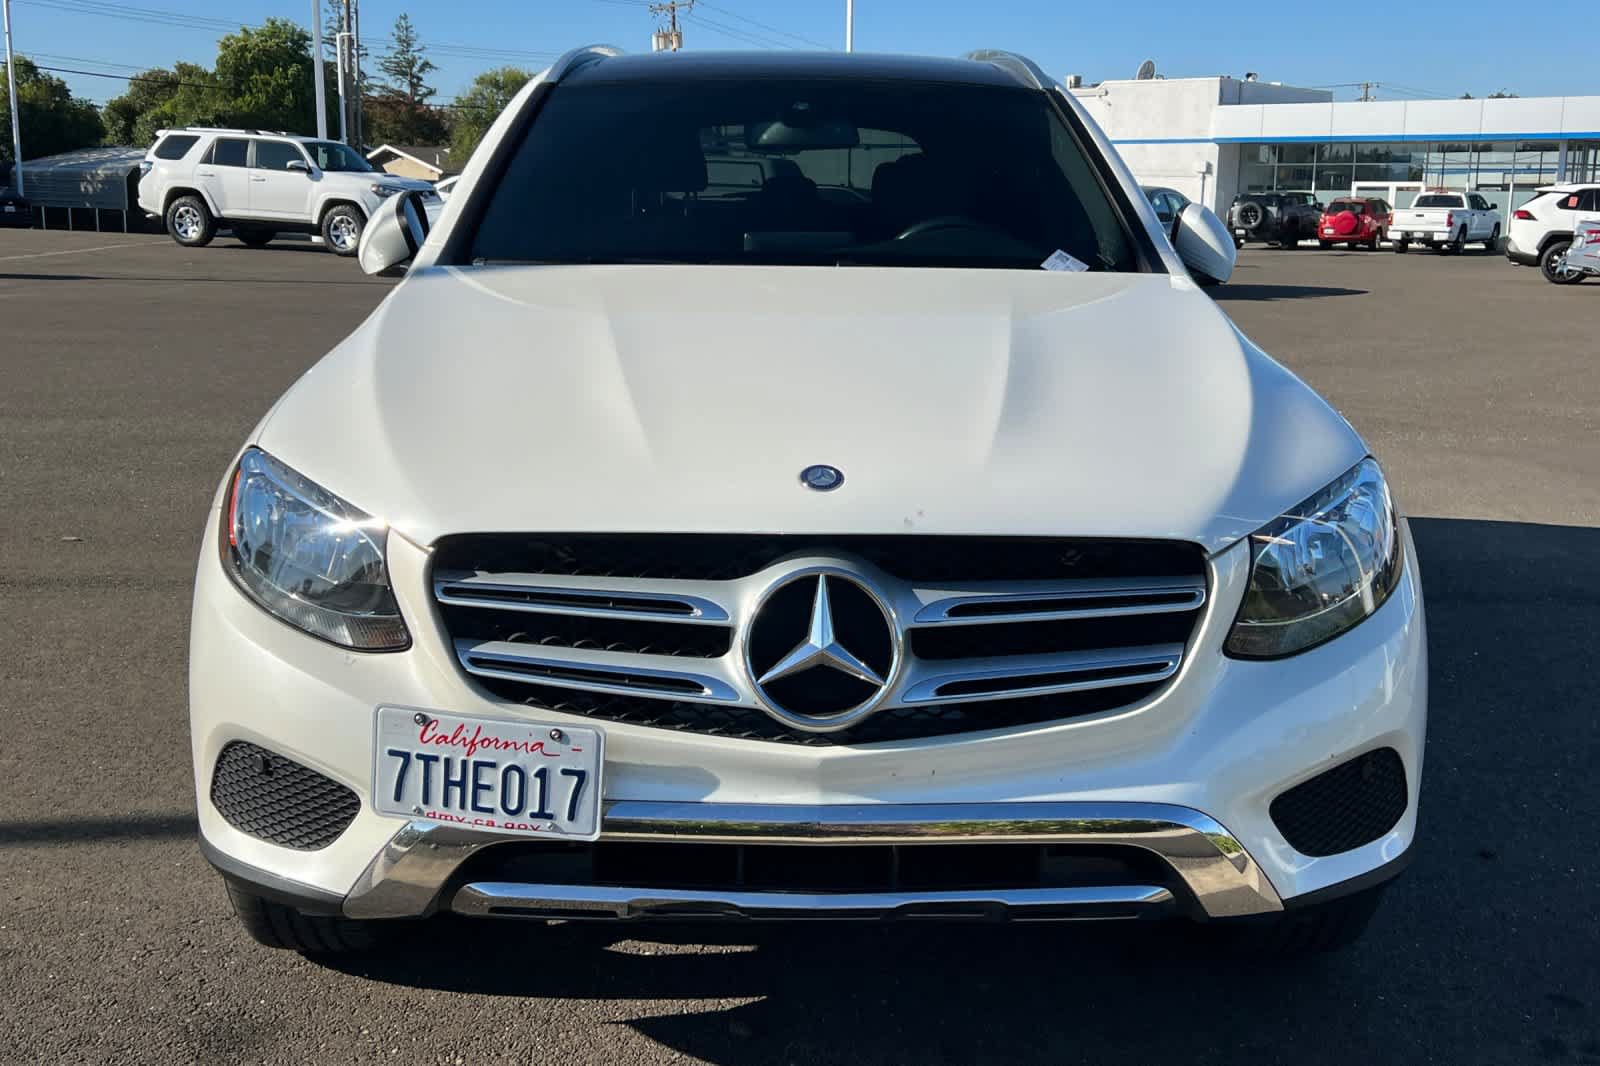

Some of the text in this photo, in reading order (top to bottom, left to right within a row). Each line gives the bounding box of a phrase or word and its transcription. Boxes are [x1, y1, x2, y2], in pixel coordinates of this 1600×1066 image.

[419, 719, 560, 757] California
[387, 749, 586, 822] 7THE017
[426, 811, 541, 831] dmv.ca.gov
